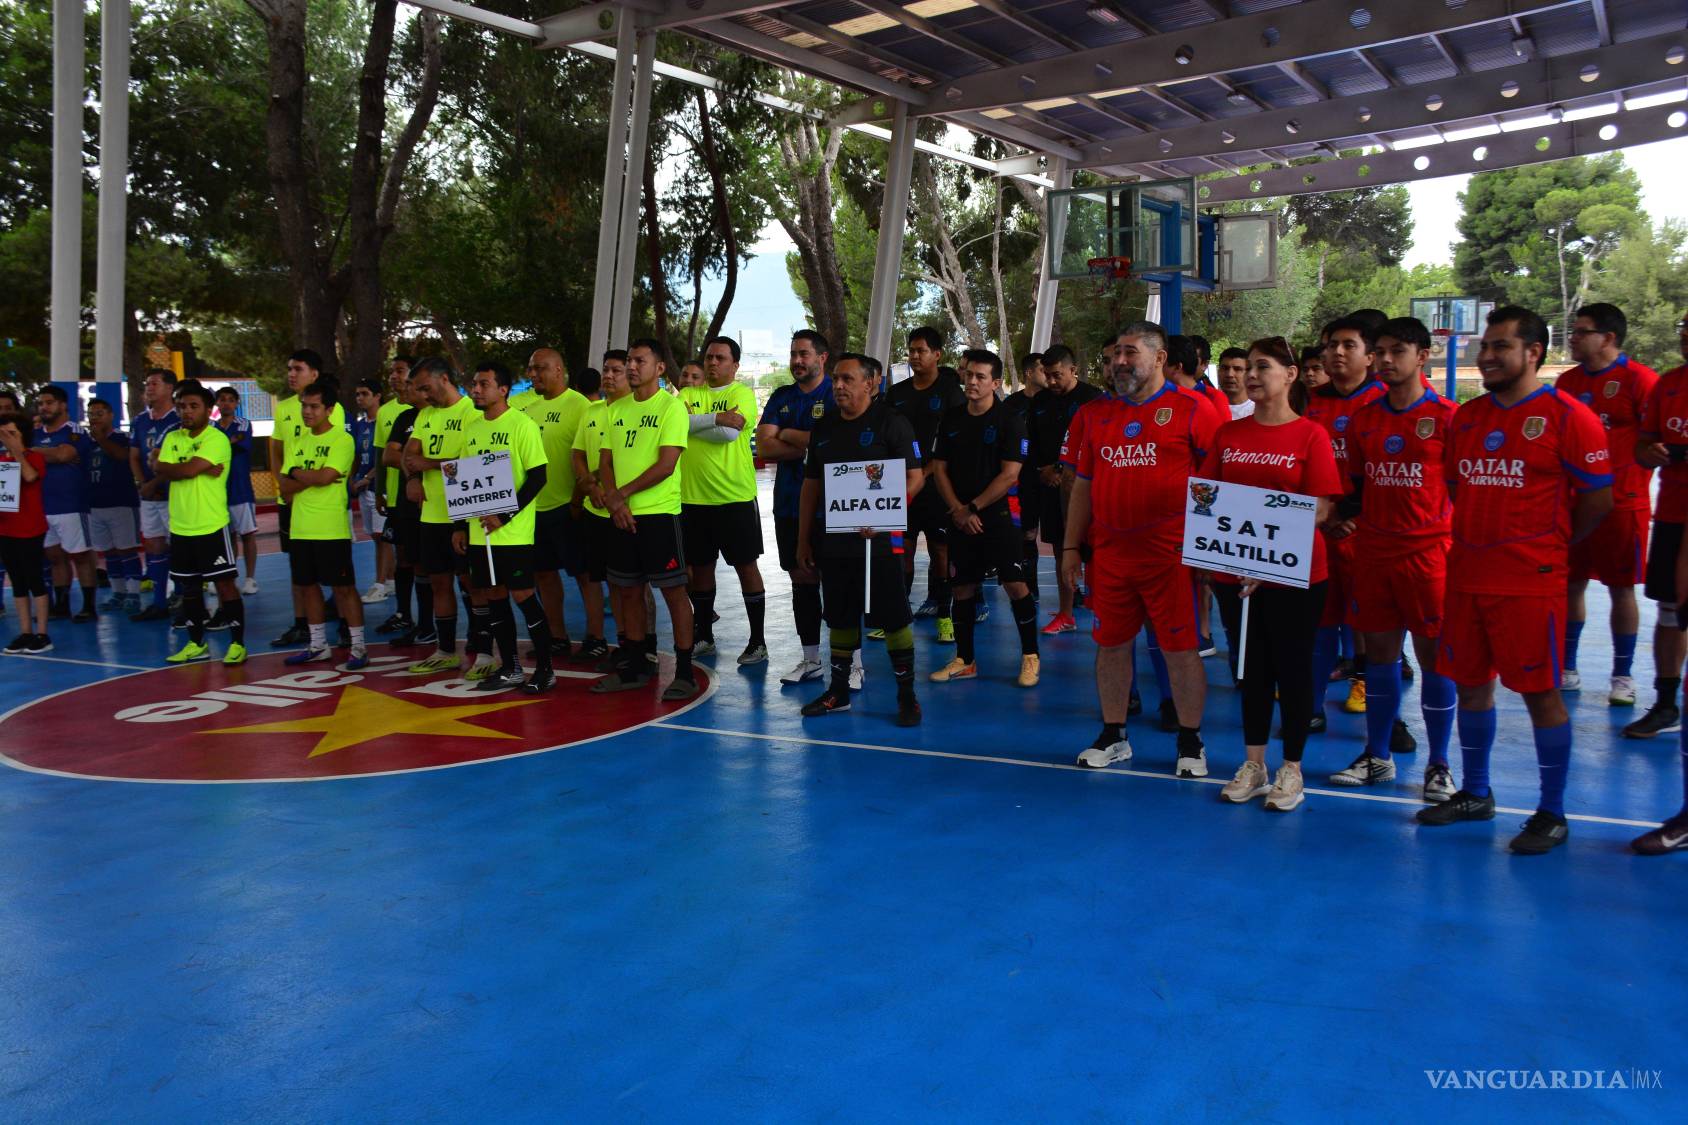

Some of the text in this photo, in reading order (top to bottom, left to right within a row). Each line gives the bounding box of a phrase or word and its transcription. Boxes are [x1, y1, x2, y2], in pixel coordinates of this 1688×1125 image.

[711, 400, 728, 412] SNL
[545, 412, 560, 423] SNL
[639, 415, 659, 428] SNL
[445, 419, 462, 431] SNL
[429, 434, 444, 455] 20
[490, 432, 509, 445] SNL
[1101, 442, 1157, 461] QATAR
[1222, 447, 1296, 469] Betancourt
[482, 454, 496, 466] 29
[1112, 456, 1157, 468] AIRWAYS
[833, 464, 848, 476] 29
[1365, 462, 1423, 478] QATAR
[1459, 459, 1525, 476] QATAR
[1375, 476, 1423, 488] AIRWAYS
[1468, 475, 1524, 488] AIRWAYS
[448, 489, 513, 507] MONTERREY
[829, 497, 901, 512] ALFA CIZ
[1264, 494, 1315, 508] 29 SAT
[1194, 536, 1298, 567] SALTILLO
